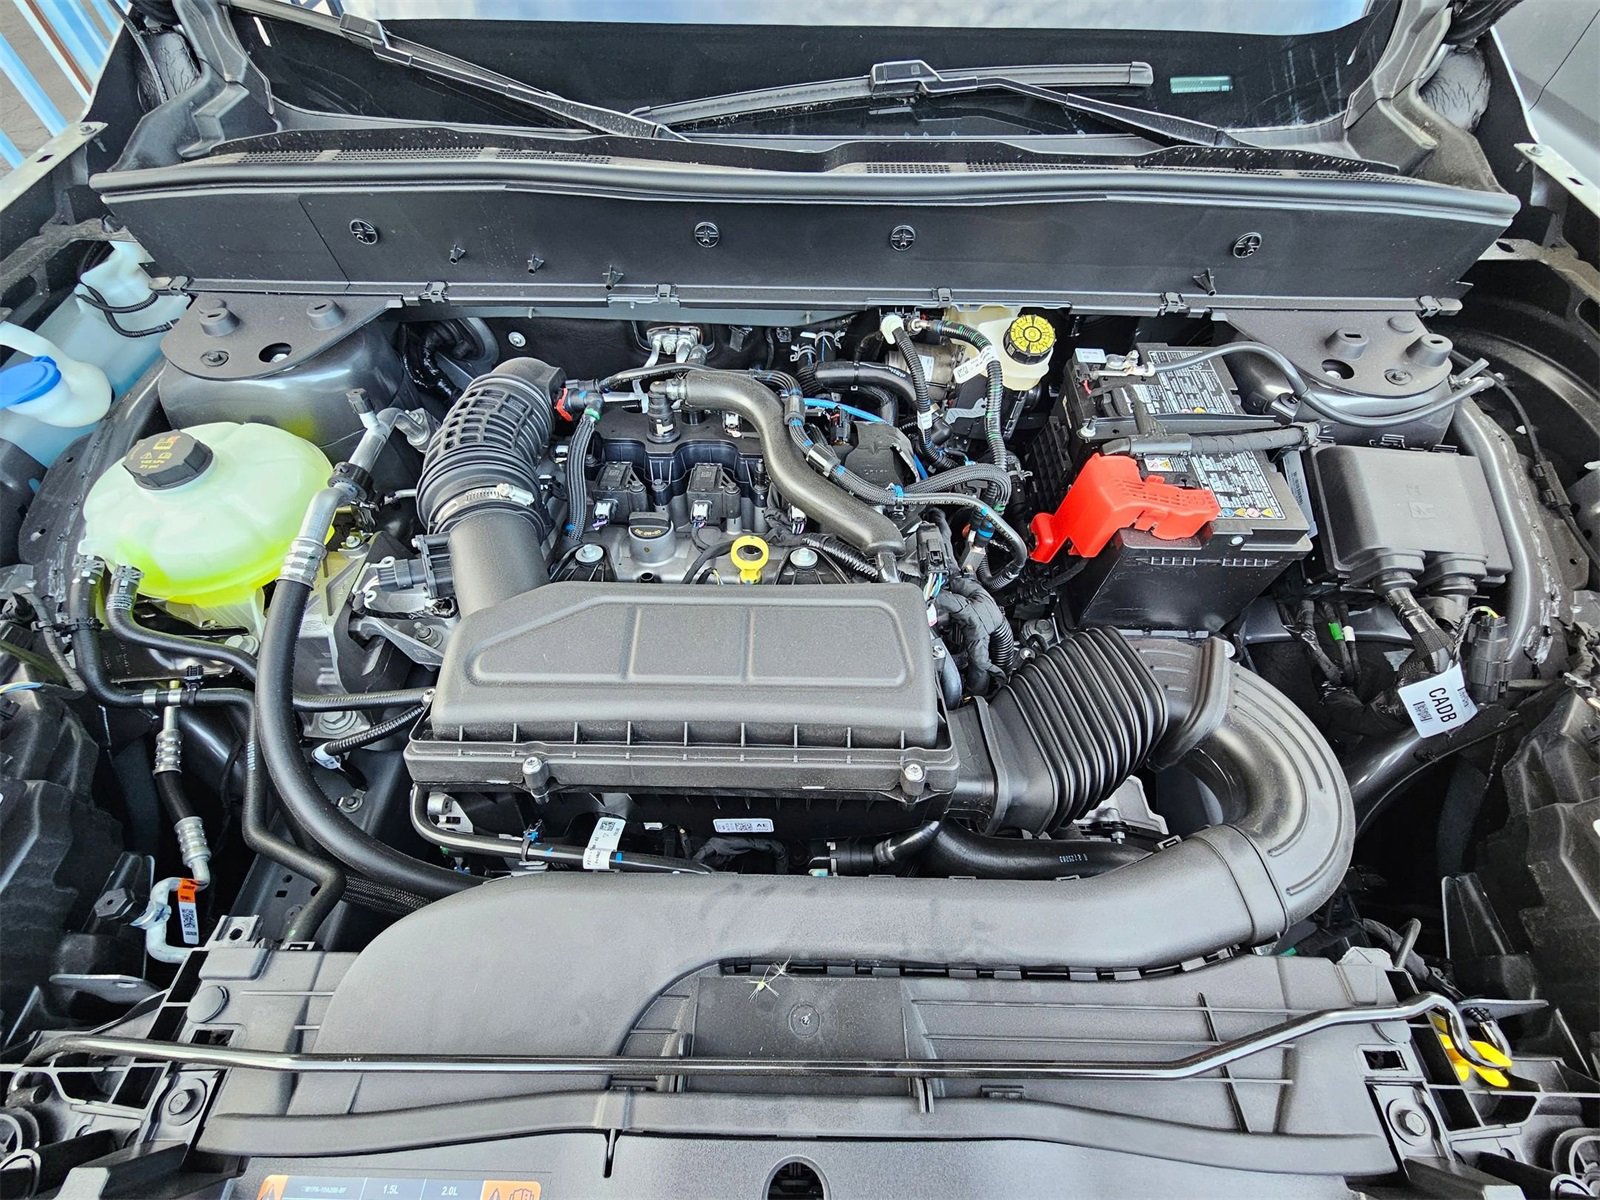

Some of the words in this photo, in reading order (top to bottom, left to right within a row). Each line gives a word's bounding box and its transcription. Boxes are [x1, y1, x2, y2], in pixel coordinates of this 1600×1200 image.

[1429, 687, 1457, 723] CADB
[383, 1184, 399, 1195] 1.5L
[441, 1186, 458, 1196] 2.0L
